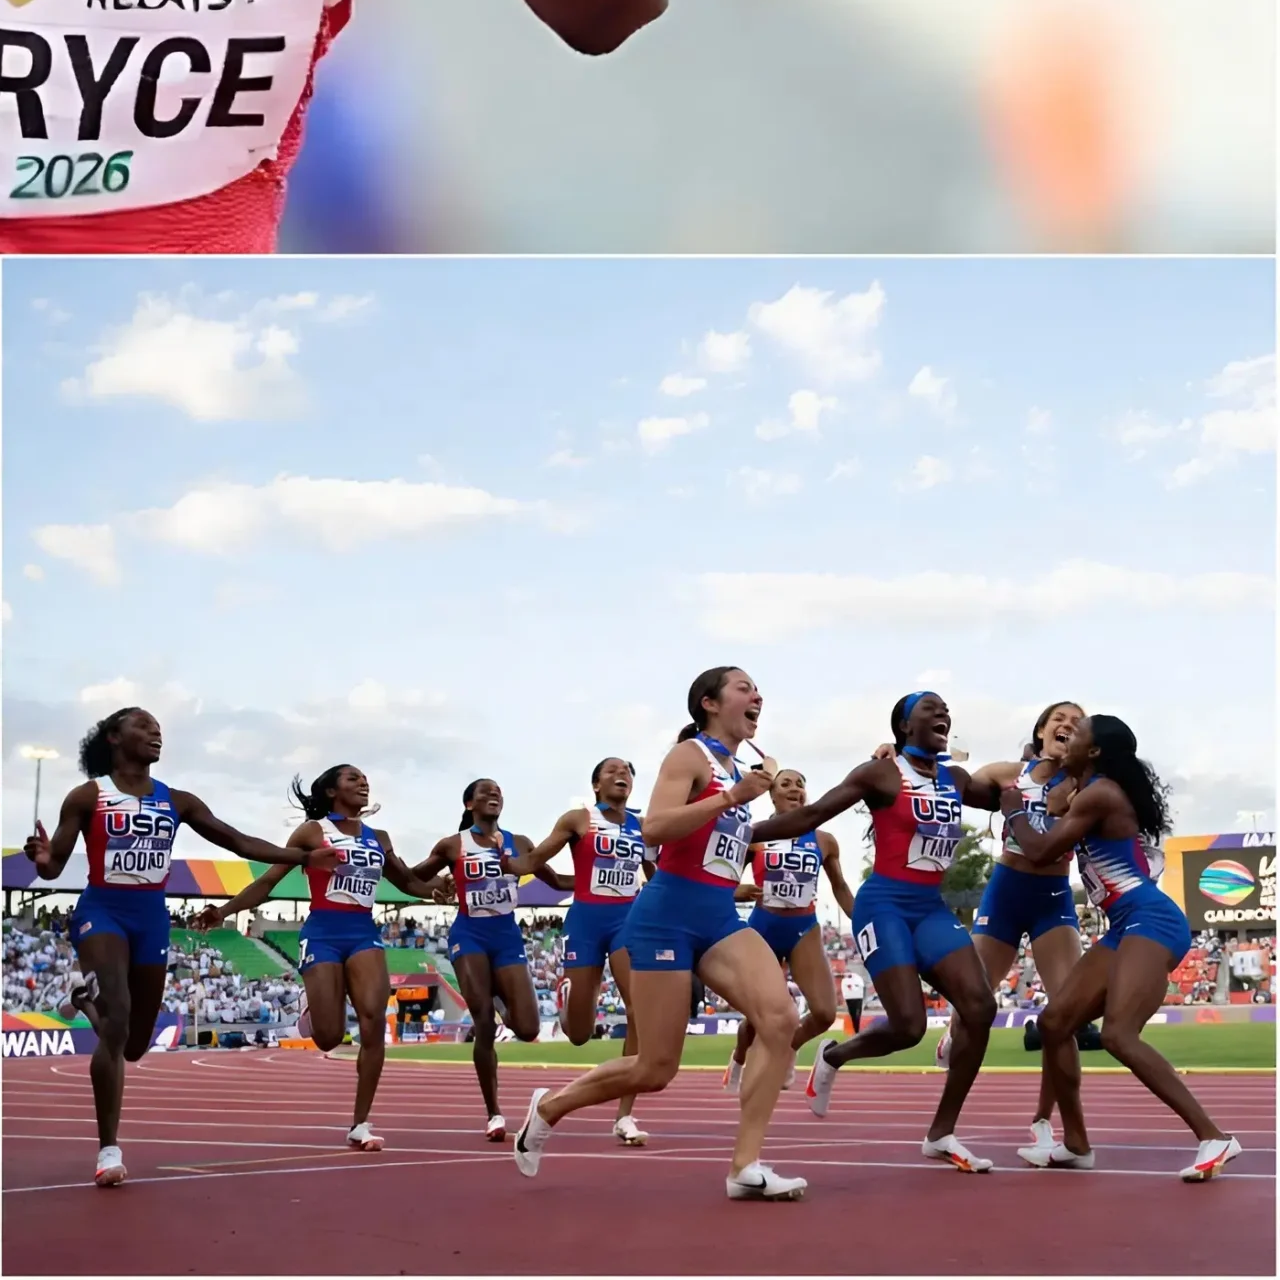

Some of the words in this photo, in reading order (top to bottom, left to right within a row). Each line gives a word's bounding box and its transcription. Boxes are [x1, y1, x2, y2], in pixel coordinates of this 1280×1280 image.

[9, 150, 134, 200] 2026
[912, 797, 962, 824] USA
[105, 813, 175, 838] USA
[594, 834, 646, 860] USA
[765, 851, 818, 872] USA
[2, 1030, 75, 1057] WANA
